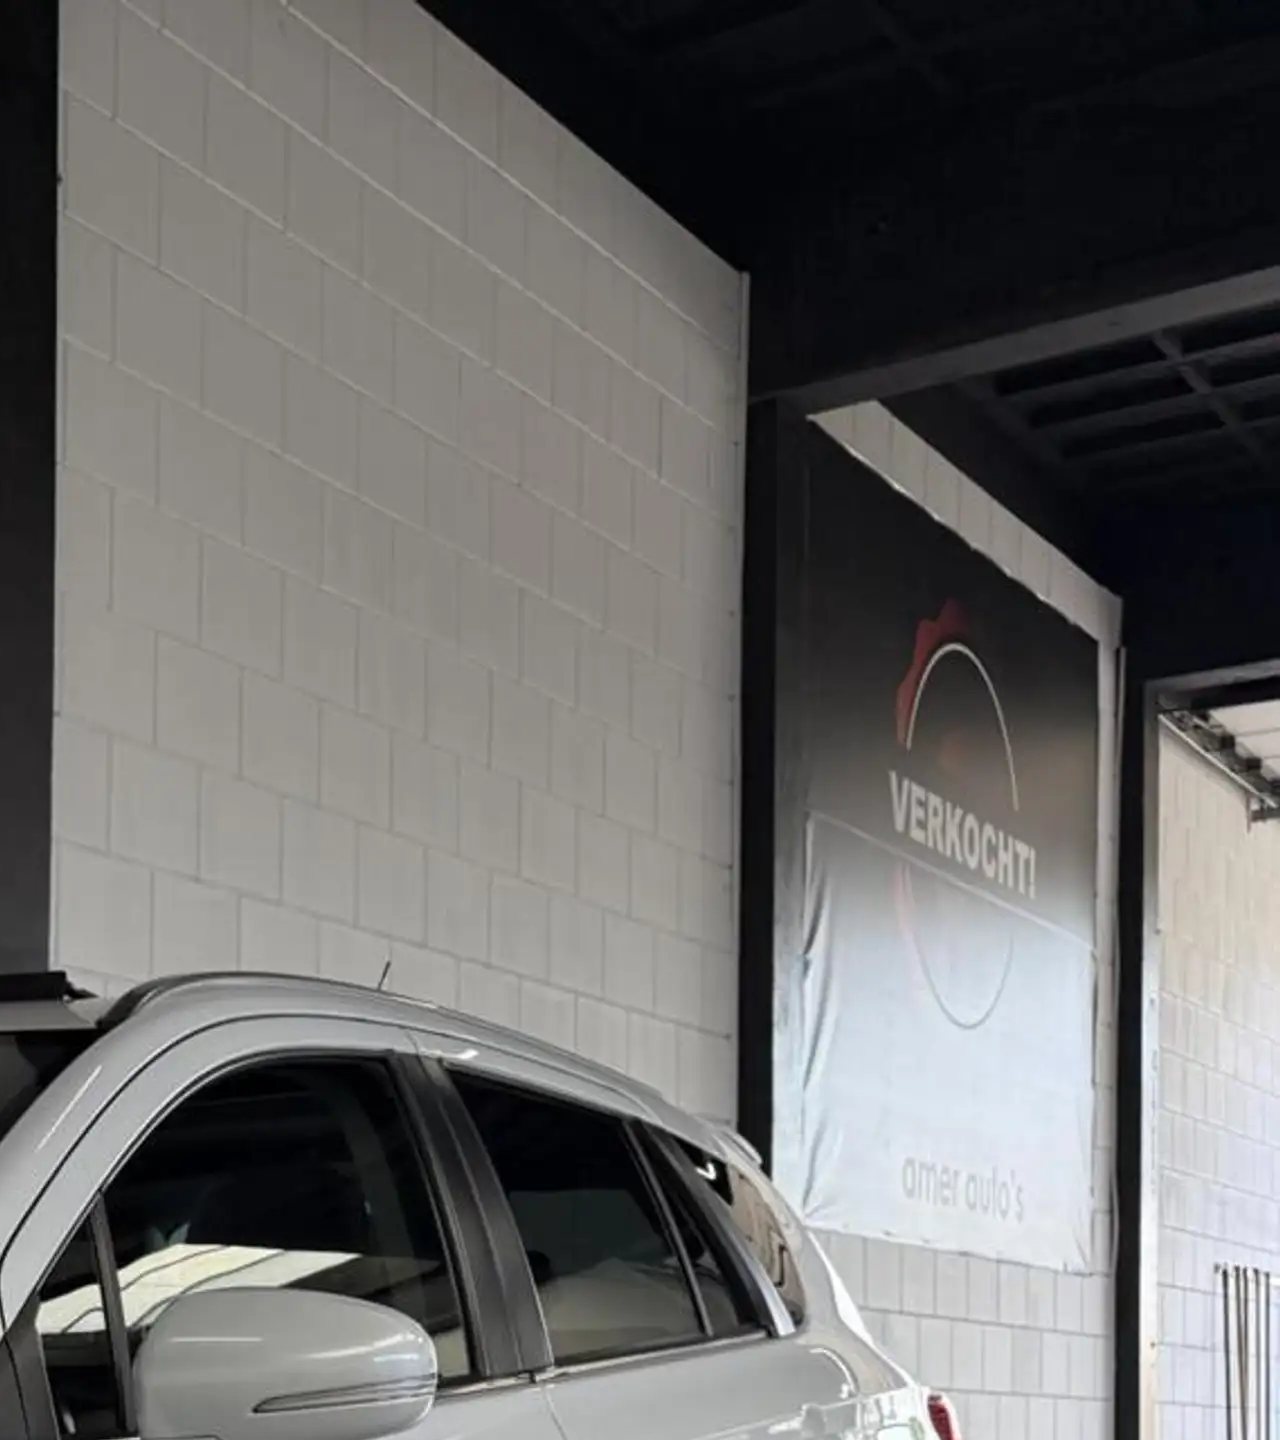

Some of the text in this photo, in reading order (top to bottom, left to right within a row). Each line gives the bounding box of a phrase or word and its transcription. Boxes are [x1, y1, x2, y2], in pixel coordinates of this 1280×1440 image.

[889, 770, 1037, 900] VERKOCHT!
[901, 1157, 1025, 1225] amer auto's
